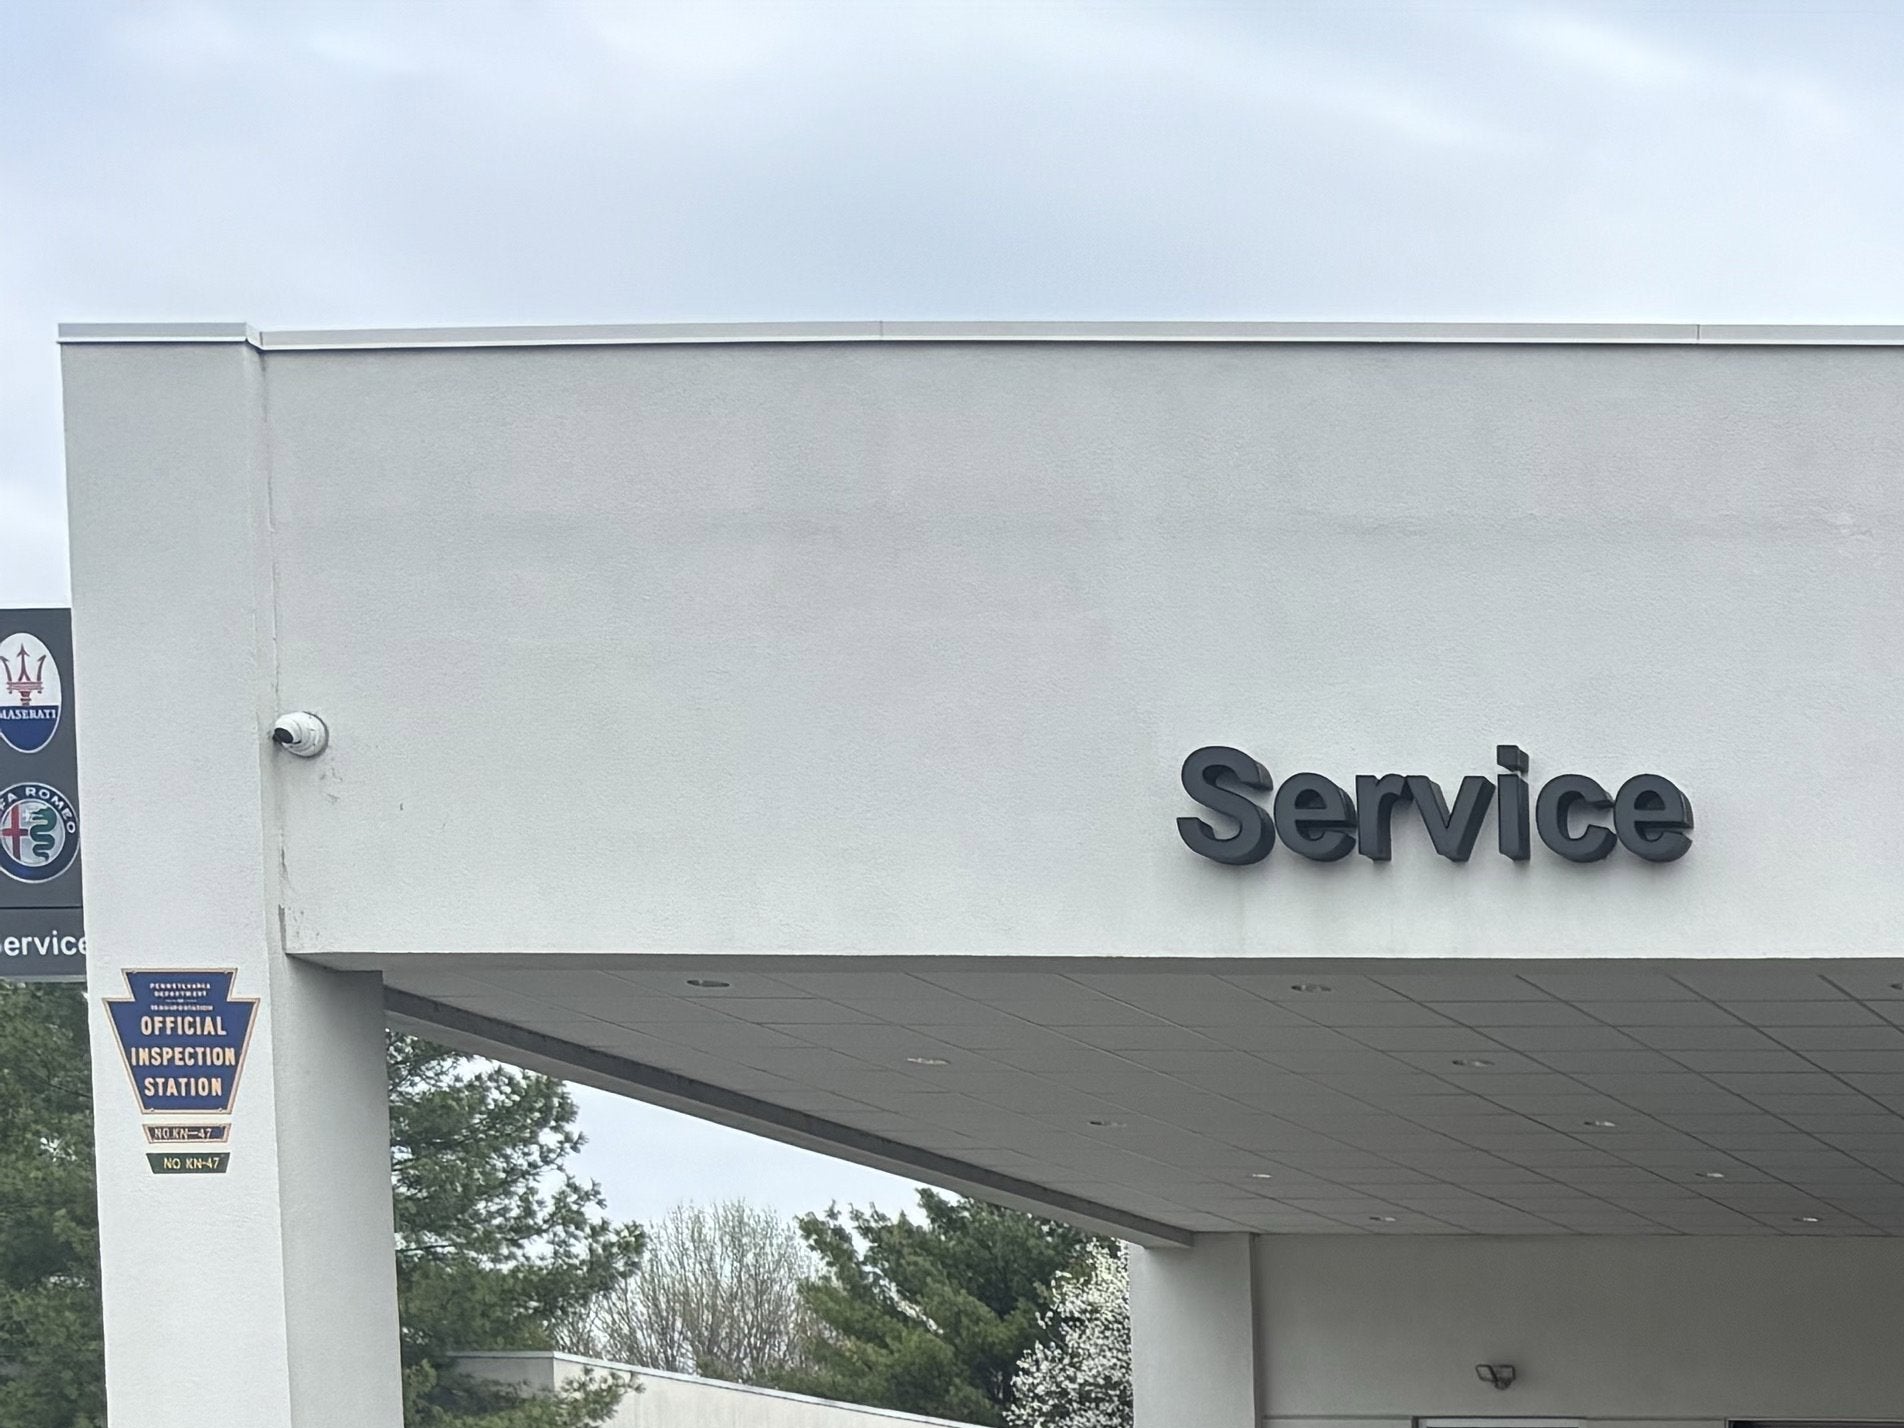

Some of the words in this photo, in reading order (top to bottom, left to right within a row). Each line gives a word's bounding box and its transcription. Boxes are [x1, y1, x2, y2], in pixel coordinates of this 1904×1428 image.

[25, 786, 77, 834] ROMEO
[1176, 744, 1695, 867] Service
[0, 930, 88, 956] ervice
[141, 1016, 227, 1036] OFFICIAL
[131, 1047, 235, 1067] INSPECTION
[144, 1077, 222, 1097] STATION
